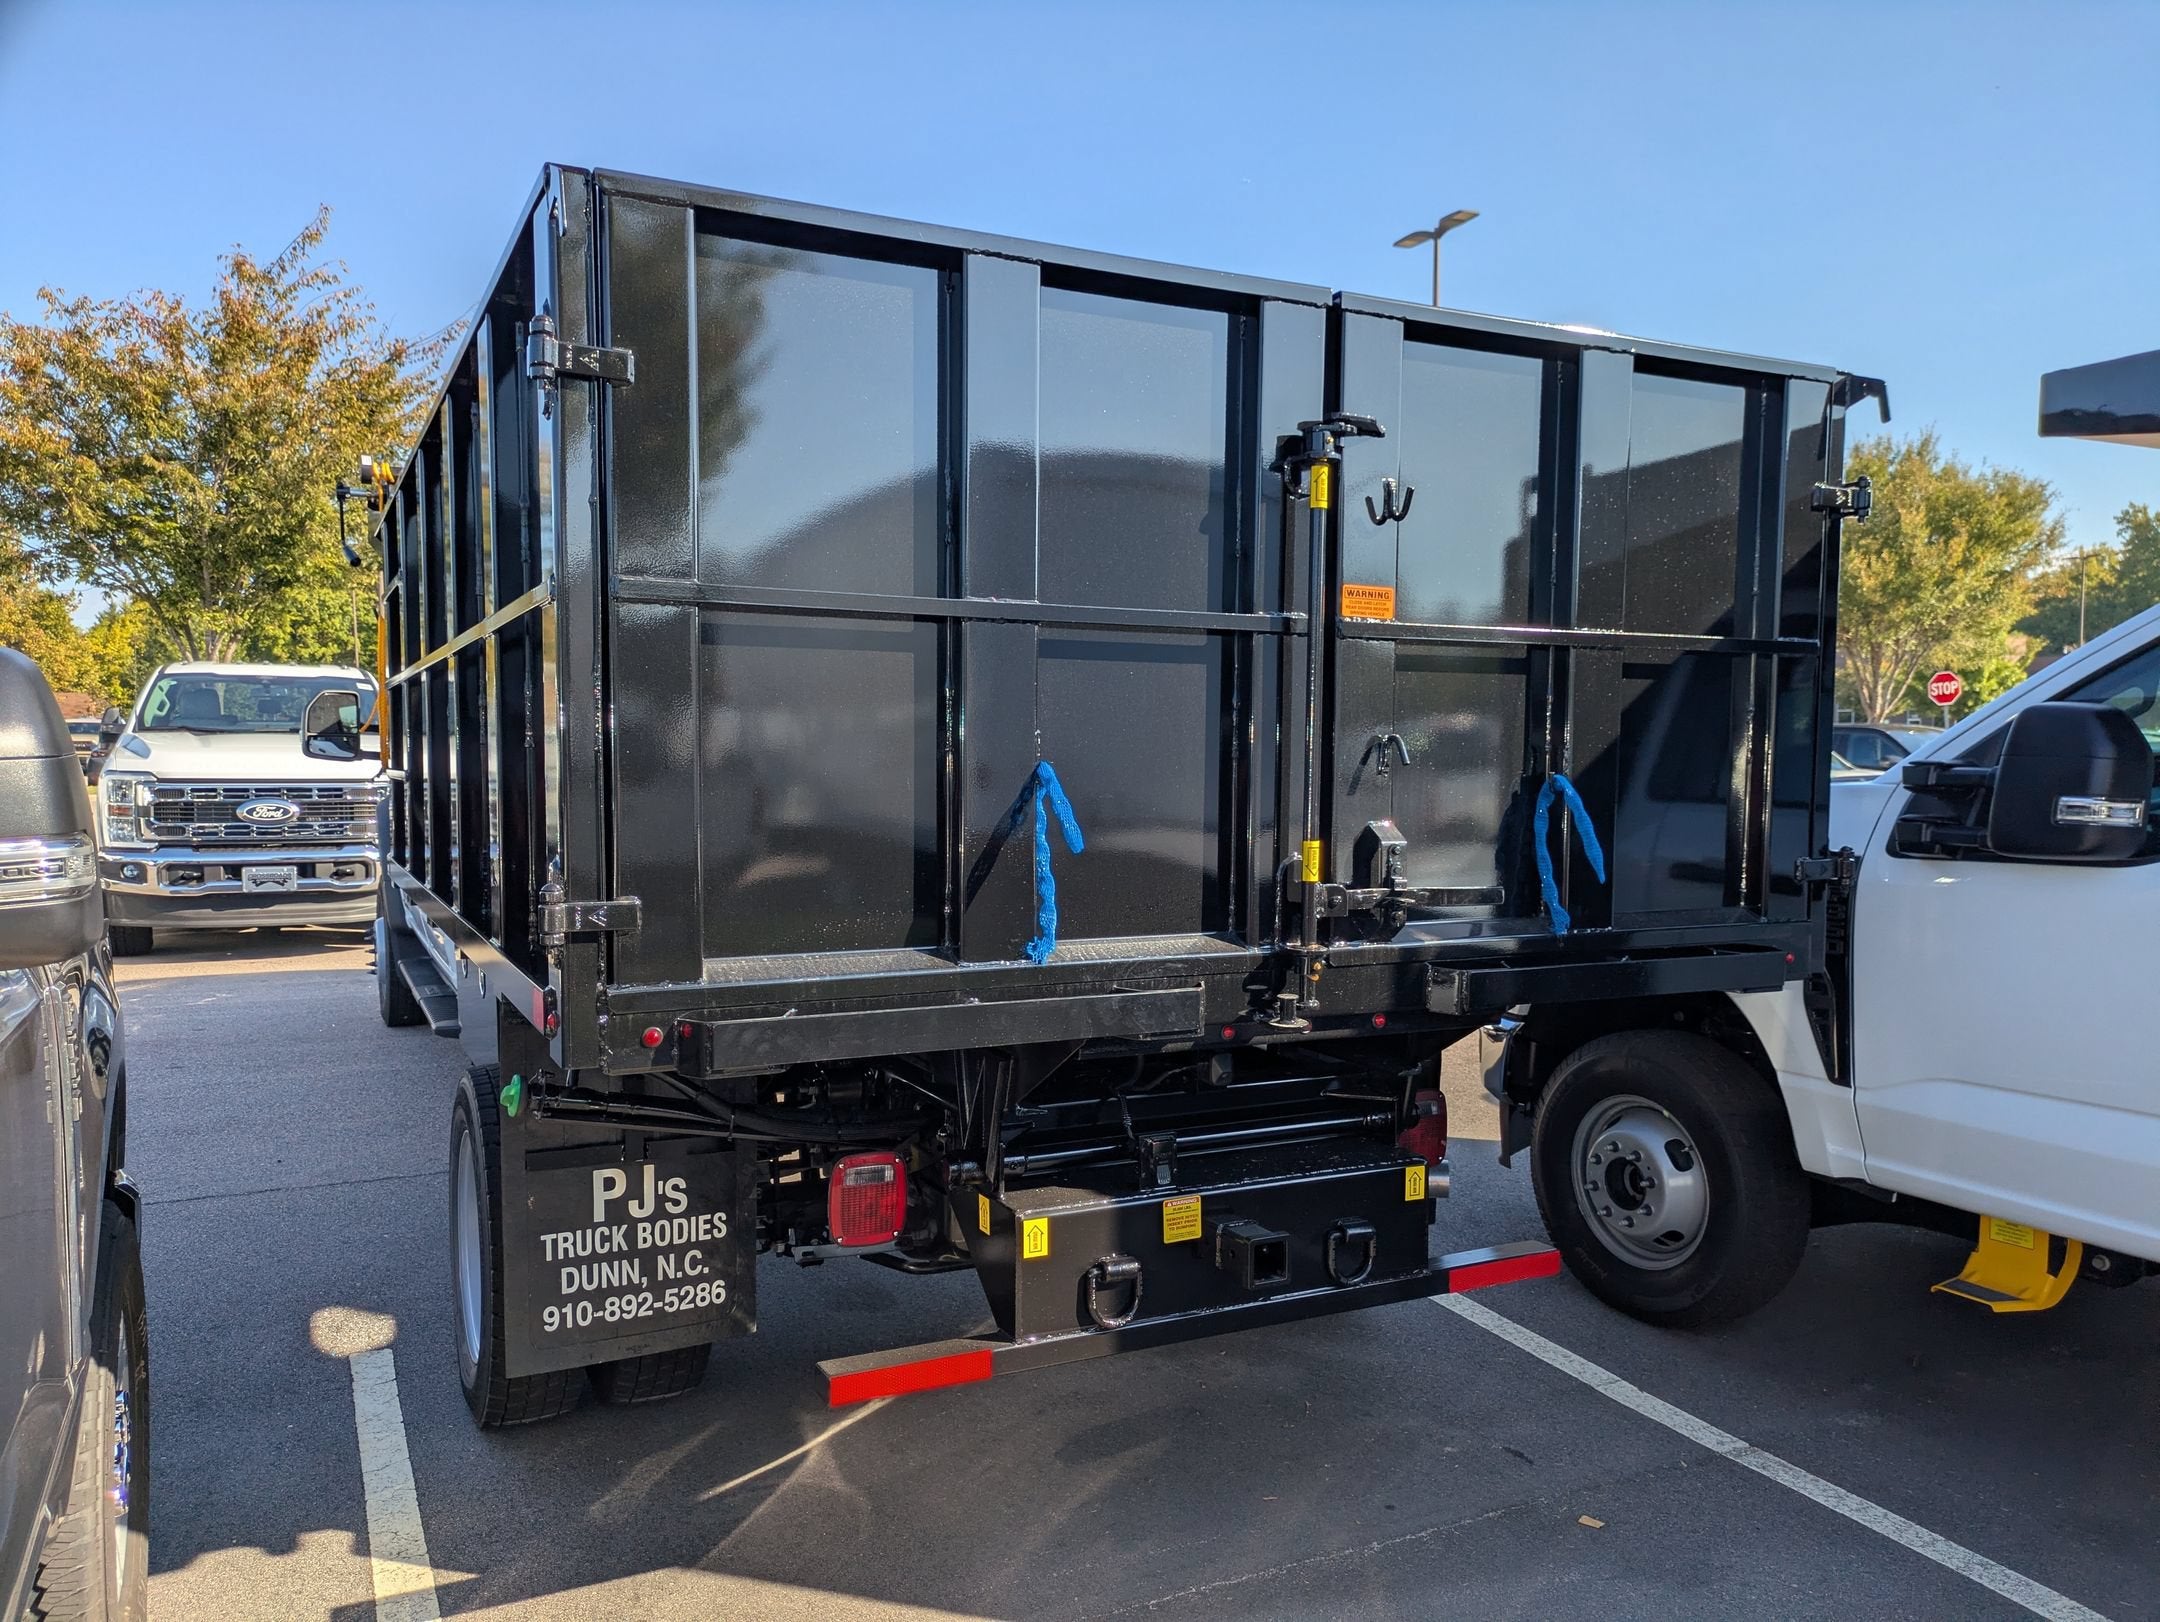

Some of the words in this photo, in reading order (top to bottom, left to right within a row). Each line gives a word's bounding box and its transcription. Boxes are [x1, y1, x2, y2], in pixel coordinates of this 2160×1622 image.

[1346, 590, 1390, 600] WARNING
[1931, 681, 1959, 697] STOP
[252, 805, 284, 818] Ford
[540, 1224, 628, 1262] TRUCK
[637, 1212, 727, 1249] BODIES
[561, 1258, 648, 1295] DUNN,
[657, 1250, 710, 1281] N.C.
[542, 1279, 727, 1332] 910-892-5286
